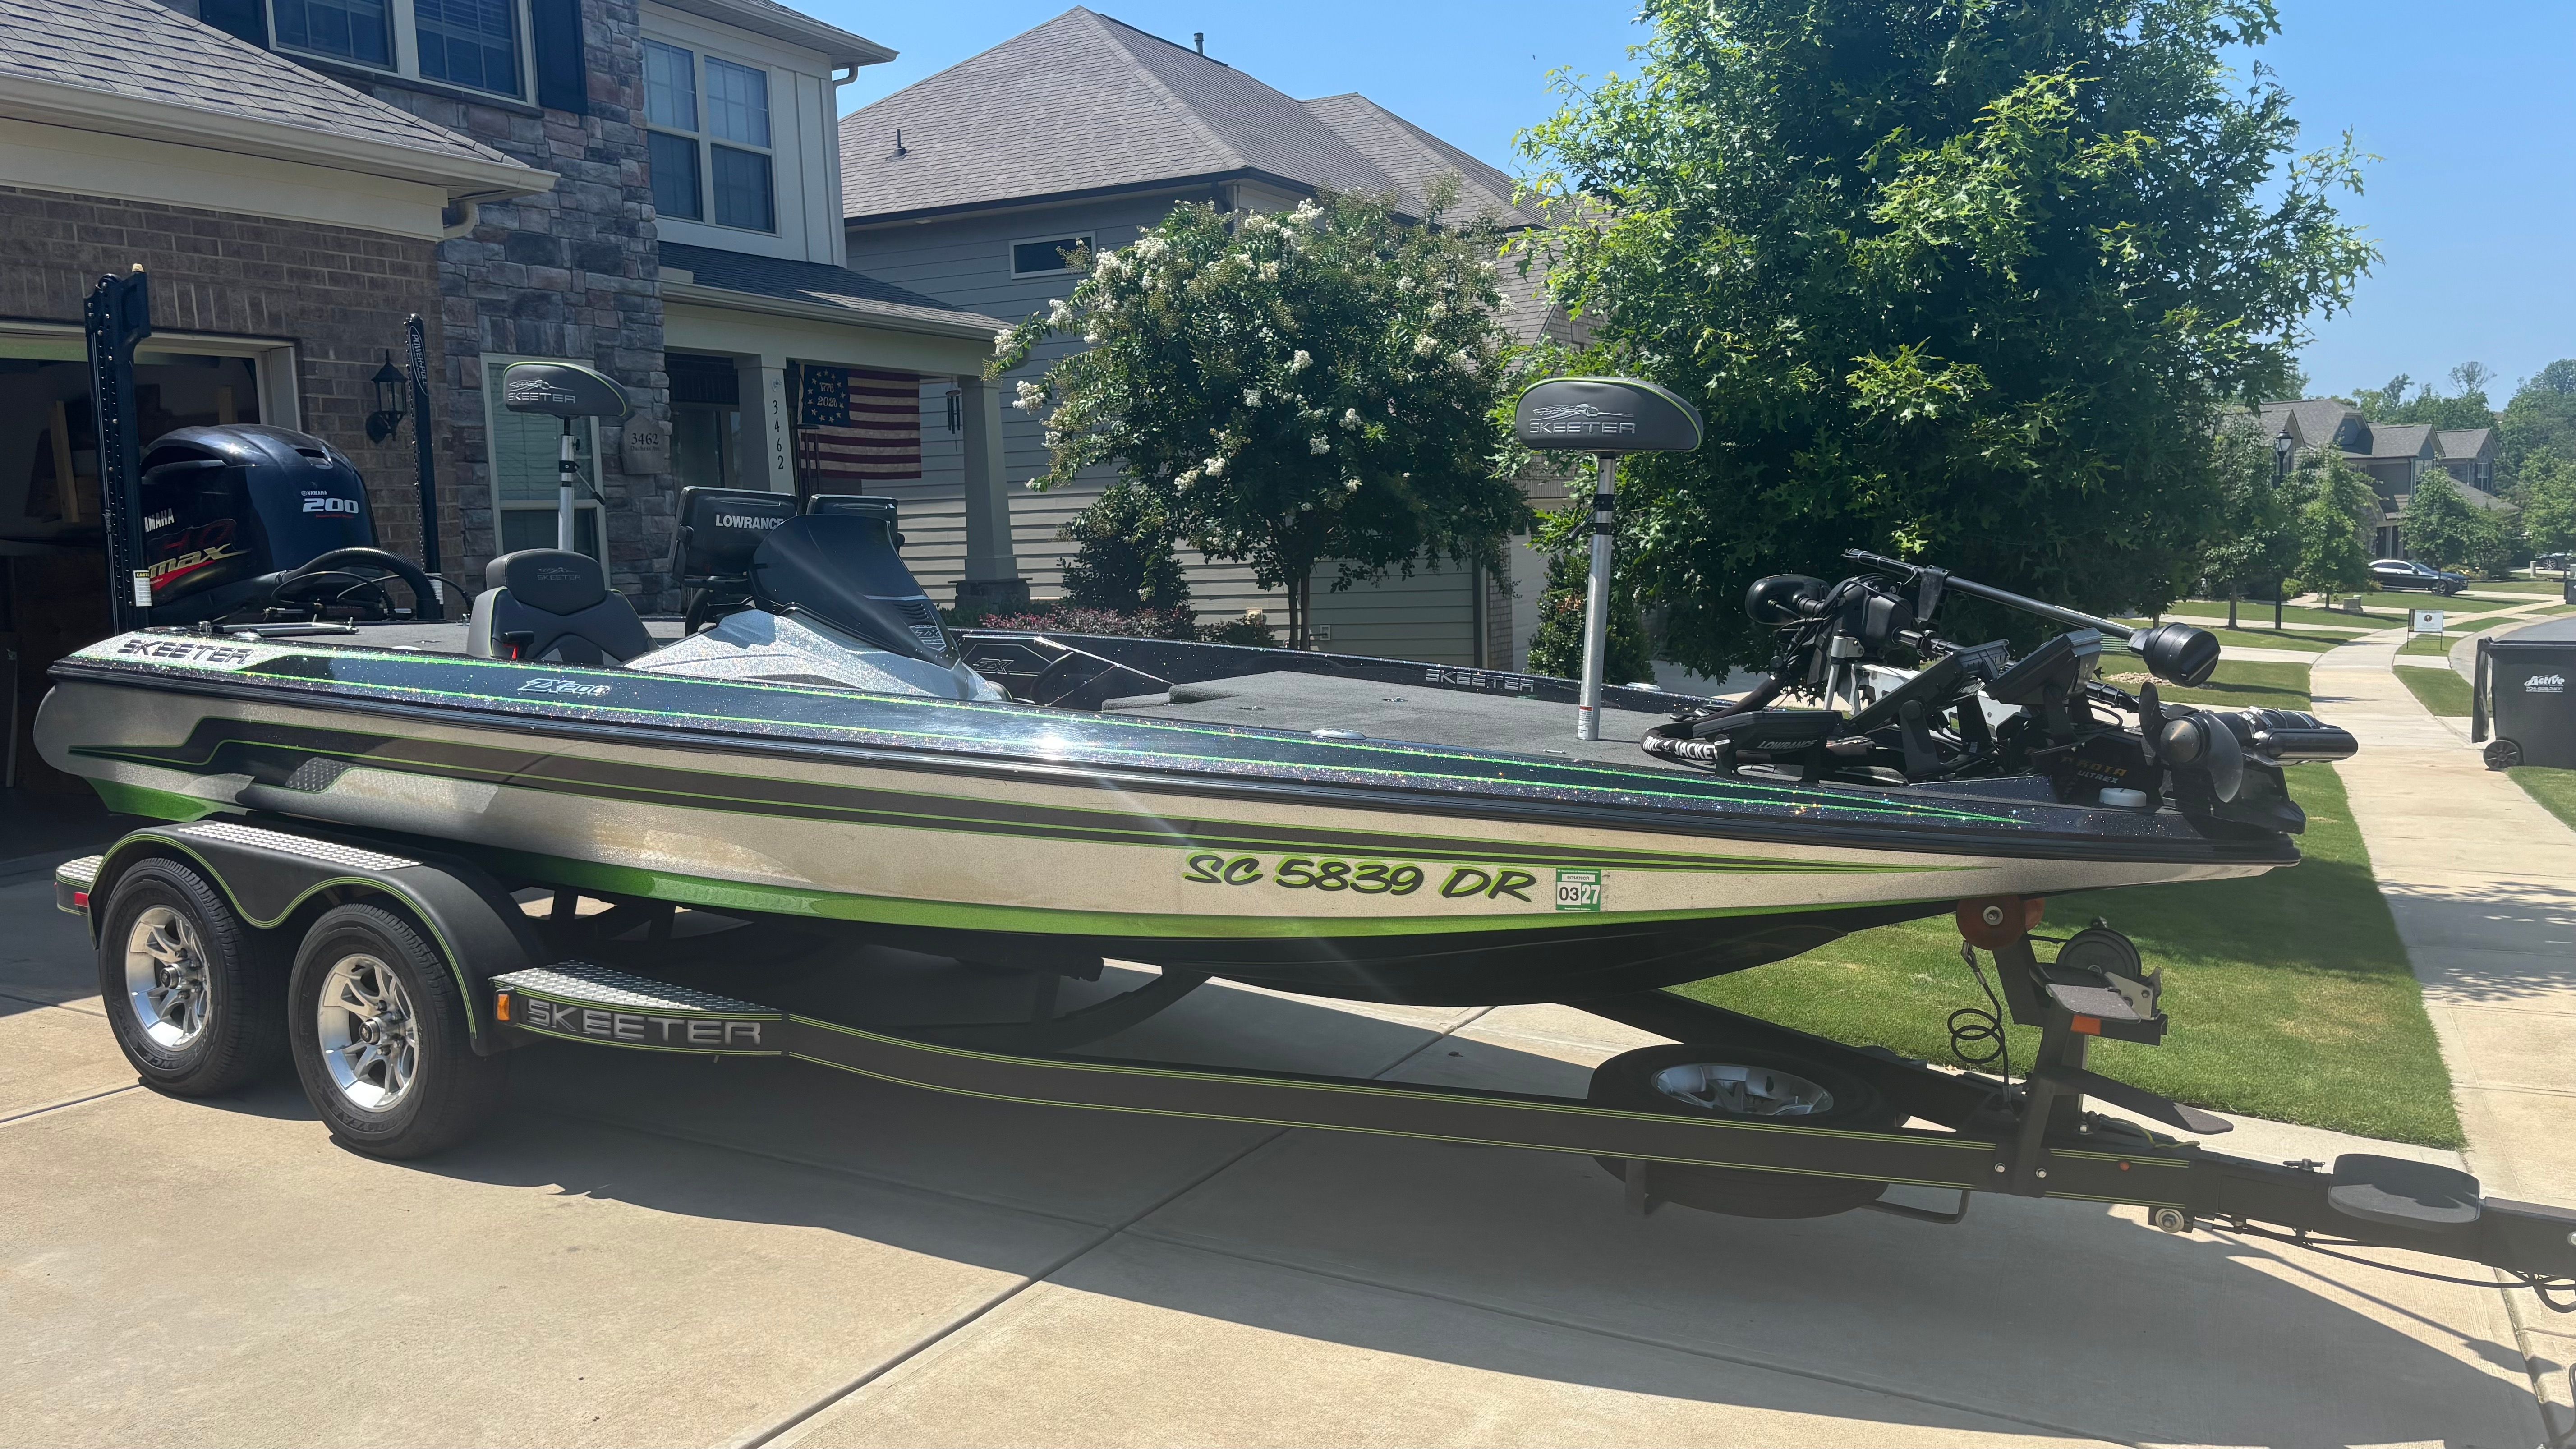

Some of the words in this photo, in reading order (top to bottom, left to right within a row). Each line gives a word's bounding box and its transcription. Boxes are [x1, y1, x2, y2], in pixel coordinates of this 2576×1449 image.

[508, 392, 576, 404] SKEETER
[773, 400, 784, 470] 3462
[1529, 422, 1636, 434] SKEETER
[631, 432, 658, 445] 3462
[303, 498, 359, 514] 200
[144, 508, 175, 533] AMAHA
[117, 639, 255, 664] SKEETER
[972, 658, 1014, 675] ZX
[1426, 669, 1534, 693] SKEETER
[2524, 674, 2565, 685] Active
[1757, 739, 1818, 750] LOWRANCE
[2077, 770, 2119, 784] ULTREX
[1182, 851, 1264, 886] SC
[1273, 855, 1424, 896] 5839
[1441, 866, 1536, 902] DR
[1559, 887, 1579, 901] 03
[1581, 884, 1600, 904] 27
[526, 999, 761, 1046] SKEETER
